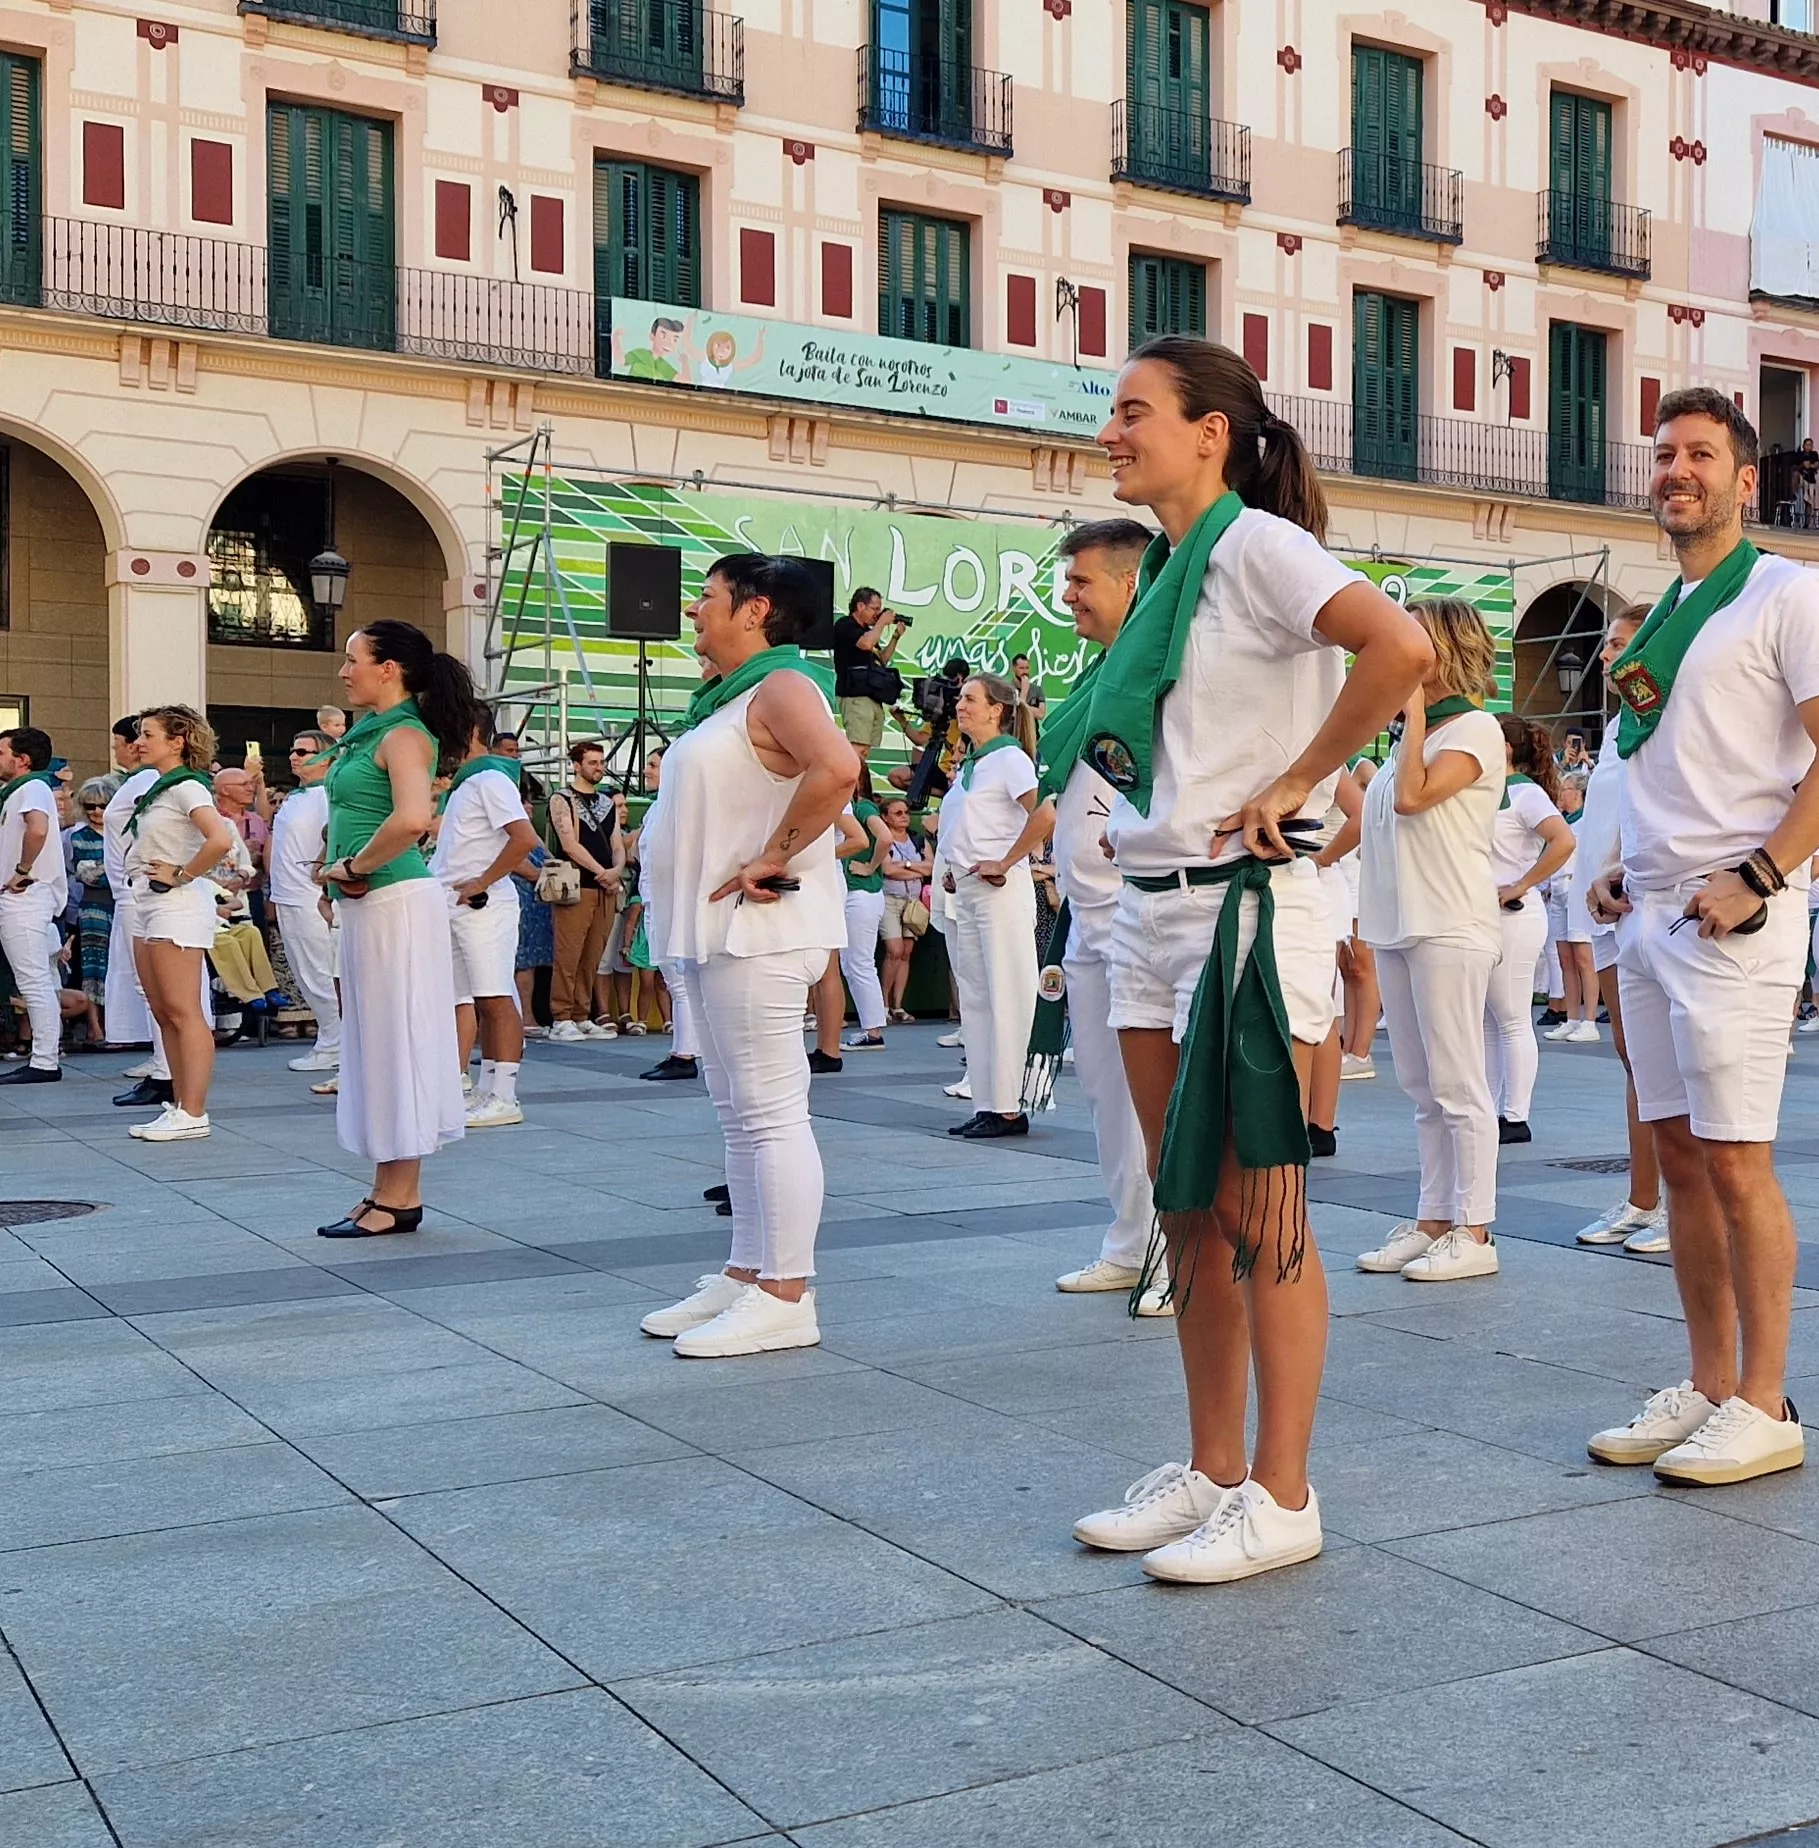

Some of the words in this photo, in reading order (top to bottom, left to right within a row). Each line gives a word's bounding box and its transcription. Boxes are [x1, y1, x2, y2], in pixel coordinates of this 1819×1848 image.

[779, 358, 796, 377] la
[794, 363, 827, 383] jota
[831, 366, 851, 384] de
[855, 368, 883, 388] San
[887, 371, 948, 397] Lorenzo
[801, 341, 847, 365] Baila
[851, 354, 875, 368] con
[878, 358, 933, 379] nosotros
